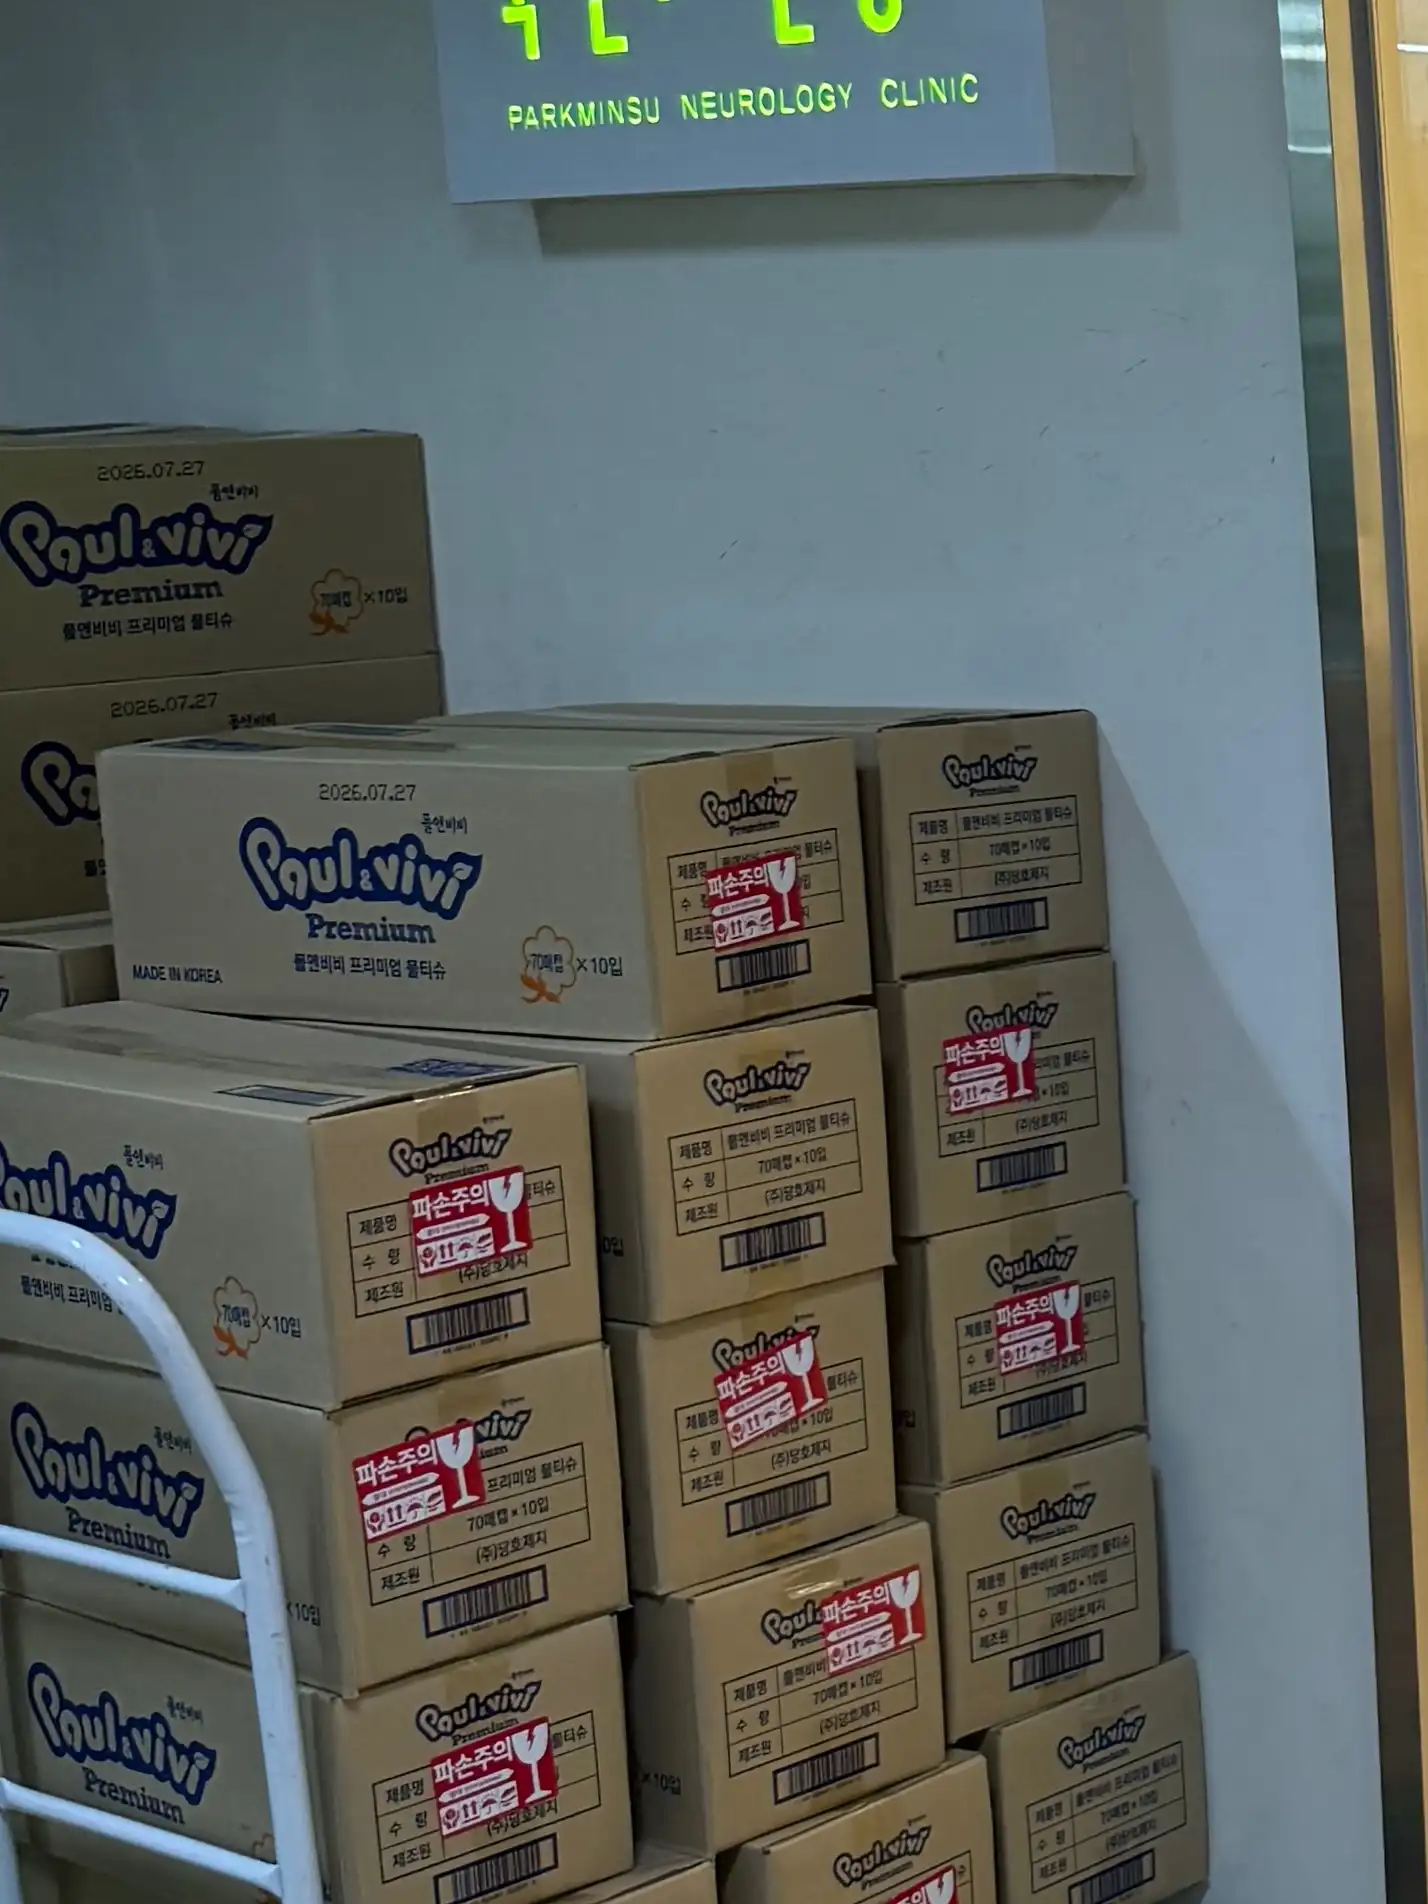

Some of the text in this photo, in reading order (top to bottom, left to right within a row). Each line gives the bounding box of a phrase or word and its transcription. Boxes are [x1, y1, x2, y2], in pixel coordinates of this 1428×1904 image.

[508, 73, 980, 131] PARKMINSU NEUROLOGY CLINIC
[78, 578, 223, 607] Premium
[126, 611, 234, 636] 프리미엄 물티슈
[707, 866, 768, 899] 파손주의
[305, 913, 436, 945] Premium
[132, 964, 224, 985] MADE IN KOREA
[350, 955, 447, 981] 프리미엄 물티슈
[412, 1180, 489, 1220] 파손주의
[717, 1356, 786, 1400] 파손주의
[356, 1440, 437, 1486] 파손주의
[488, 1468, 536, 1492] 프리미엄
[64, 1507, 171, 1560] Premium
[823, 1583, 890, 1623] 파손주의
[432, 1736, 512, 1785] 파손주의
[82, 1766, 185, 1826] Premium
